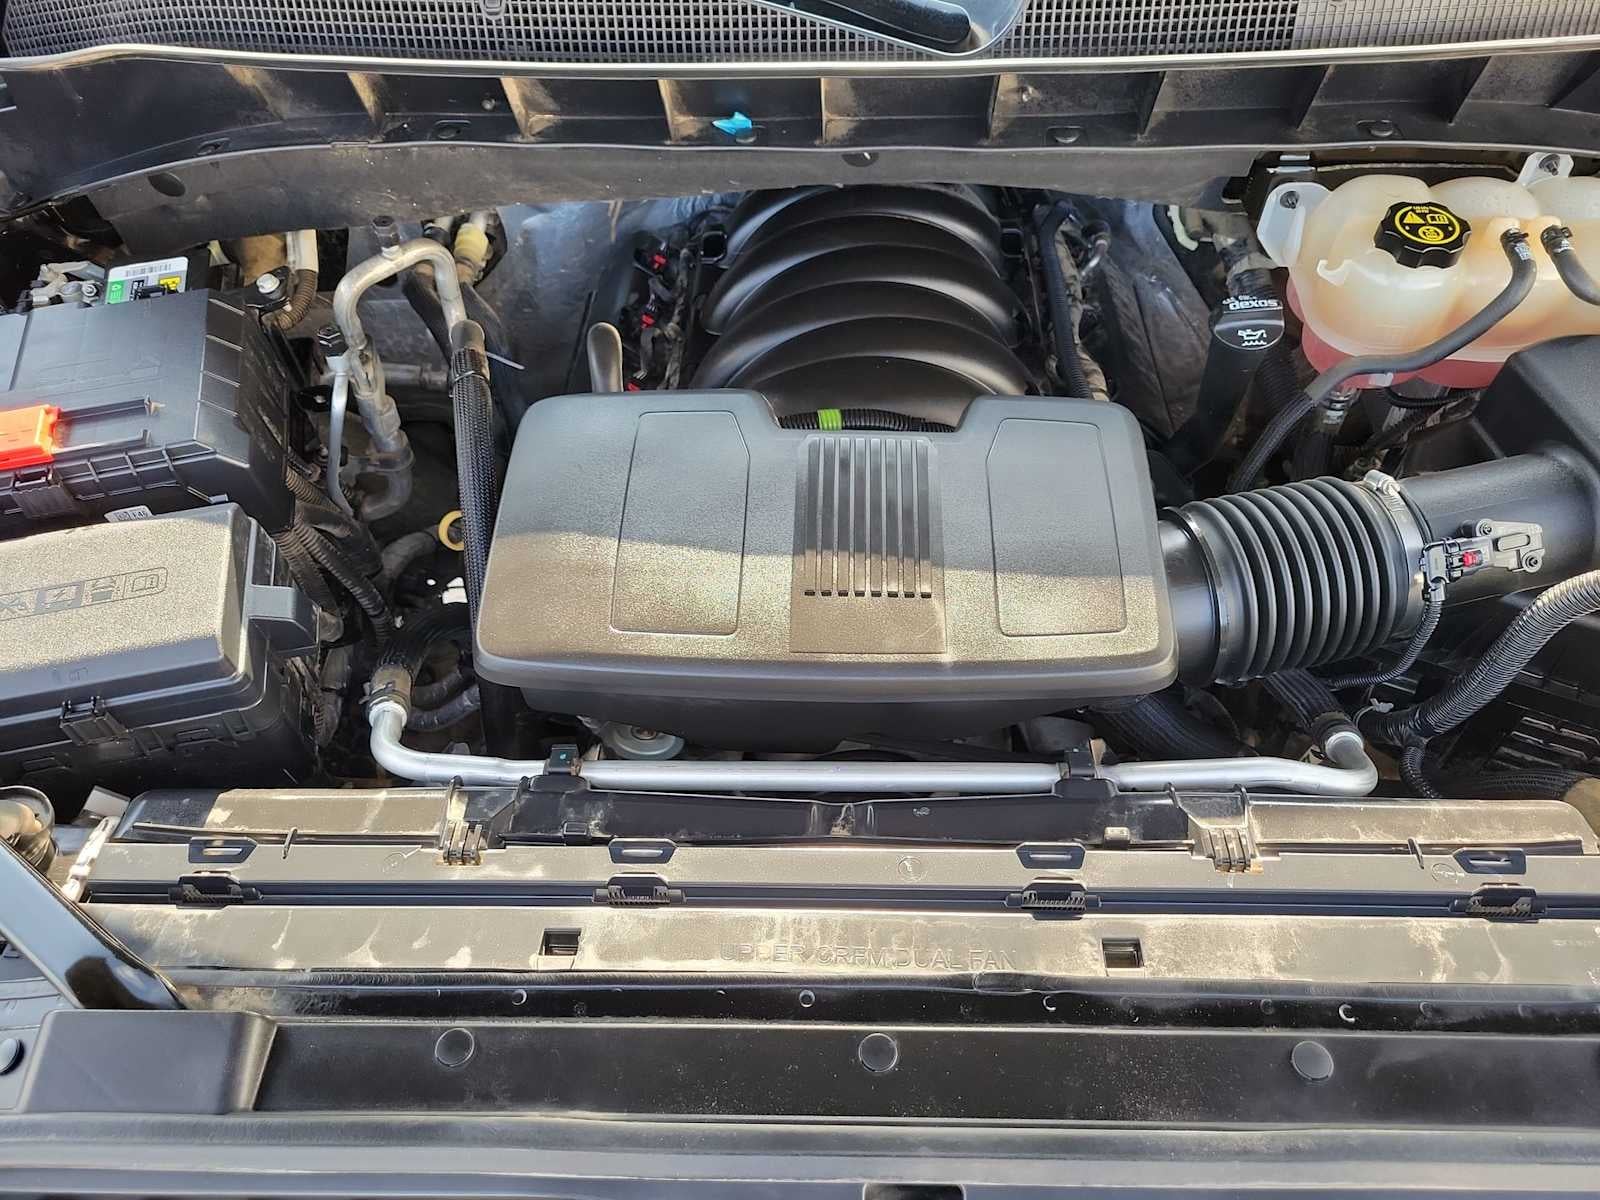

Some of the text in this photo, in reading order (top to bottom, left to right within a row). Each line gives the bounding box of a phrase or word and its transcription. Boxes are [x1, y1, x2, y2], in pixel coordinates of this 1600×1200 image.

[1229, 298, 1279, 310] dexos
[893, 946, 963, 969] DUAL
[967, 948, 1017, 971] FAN
